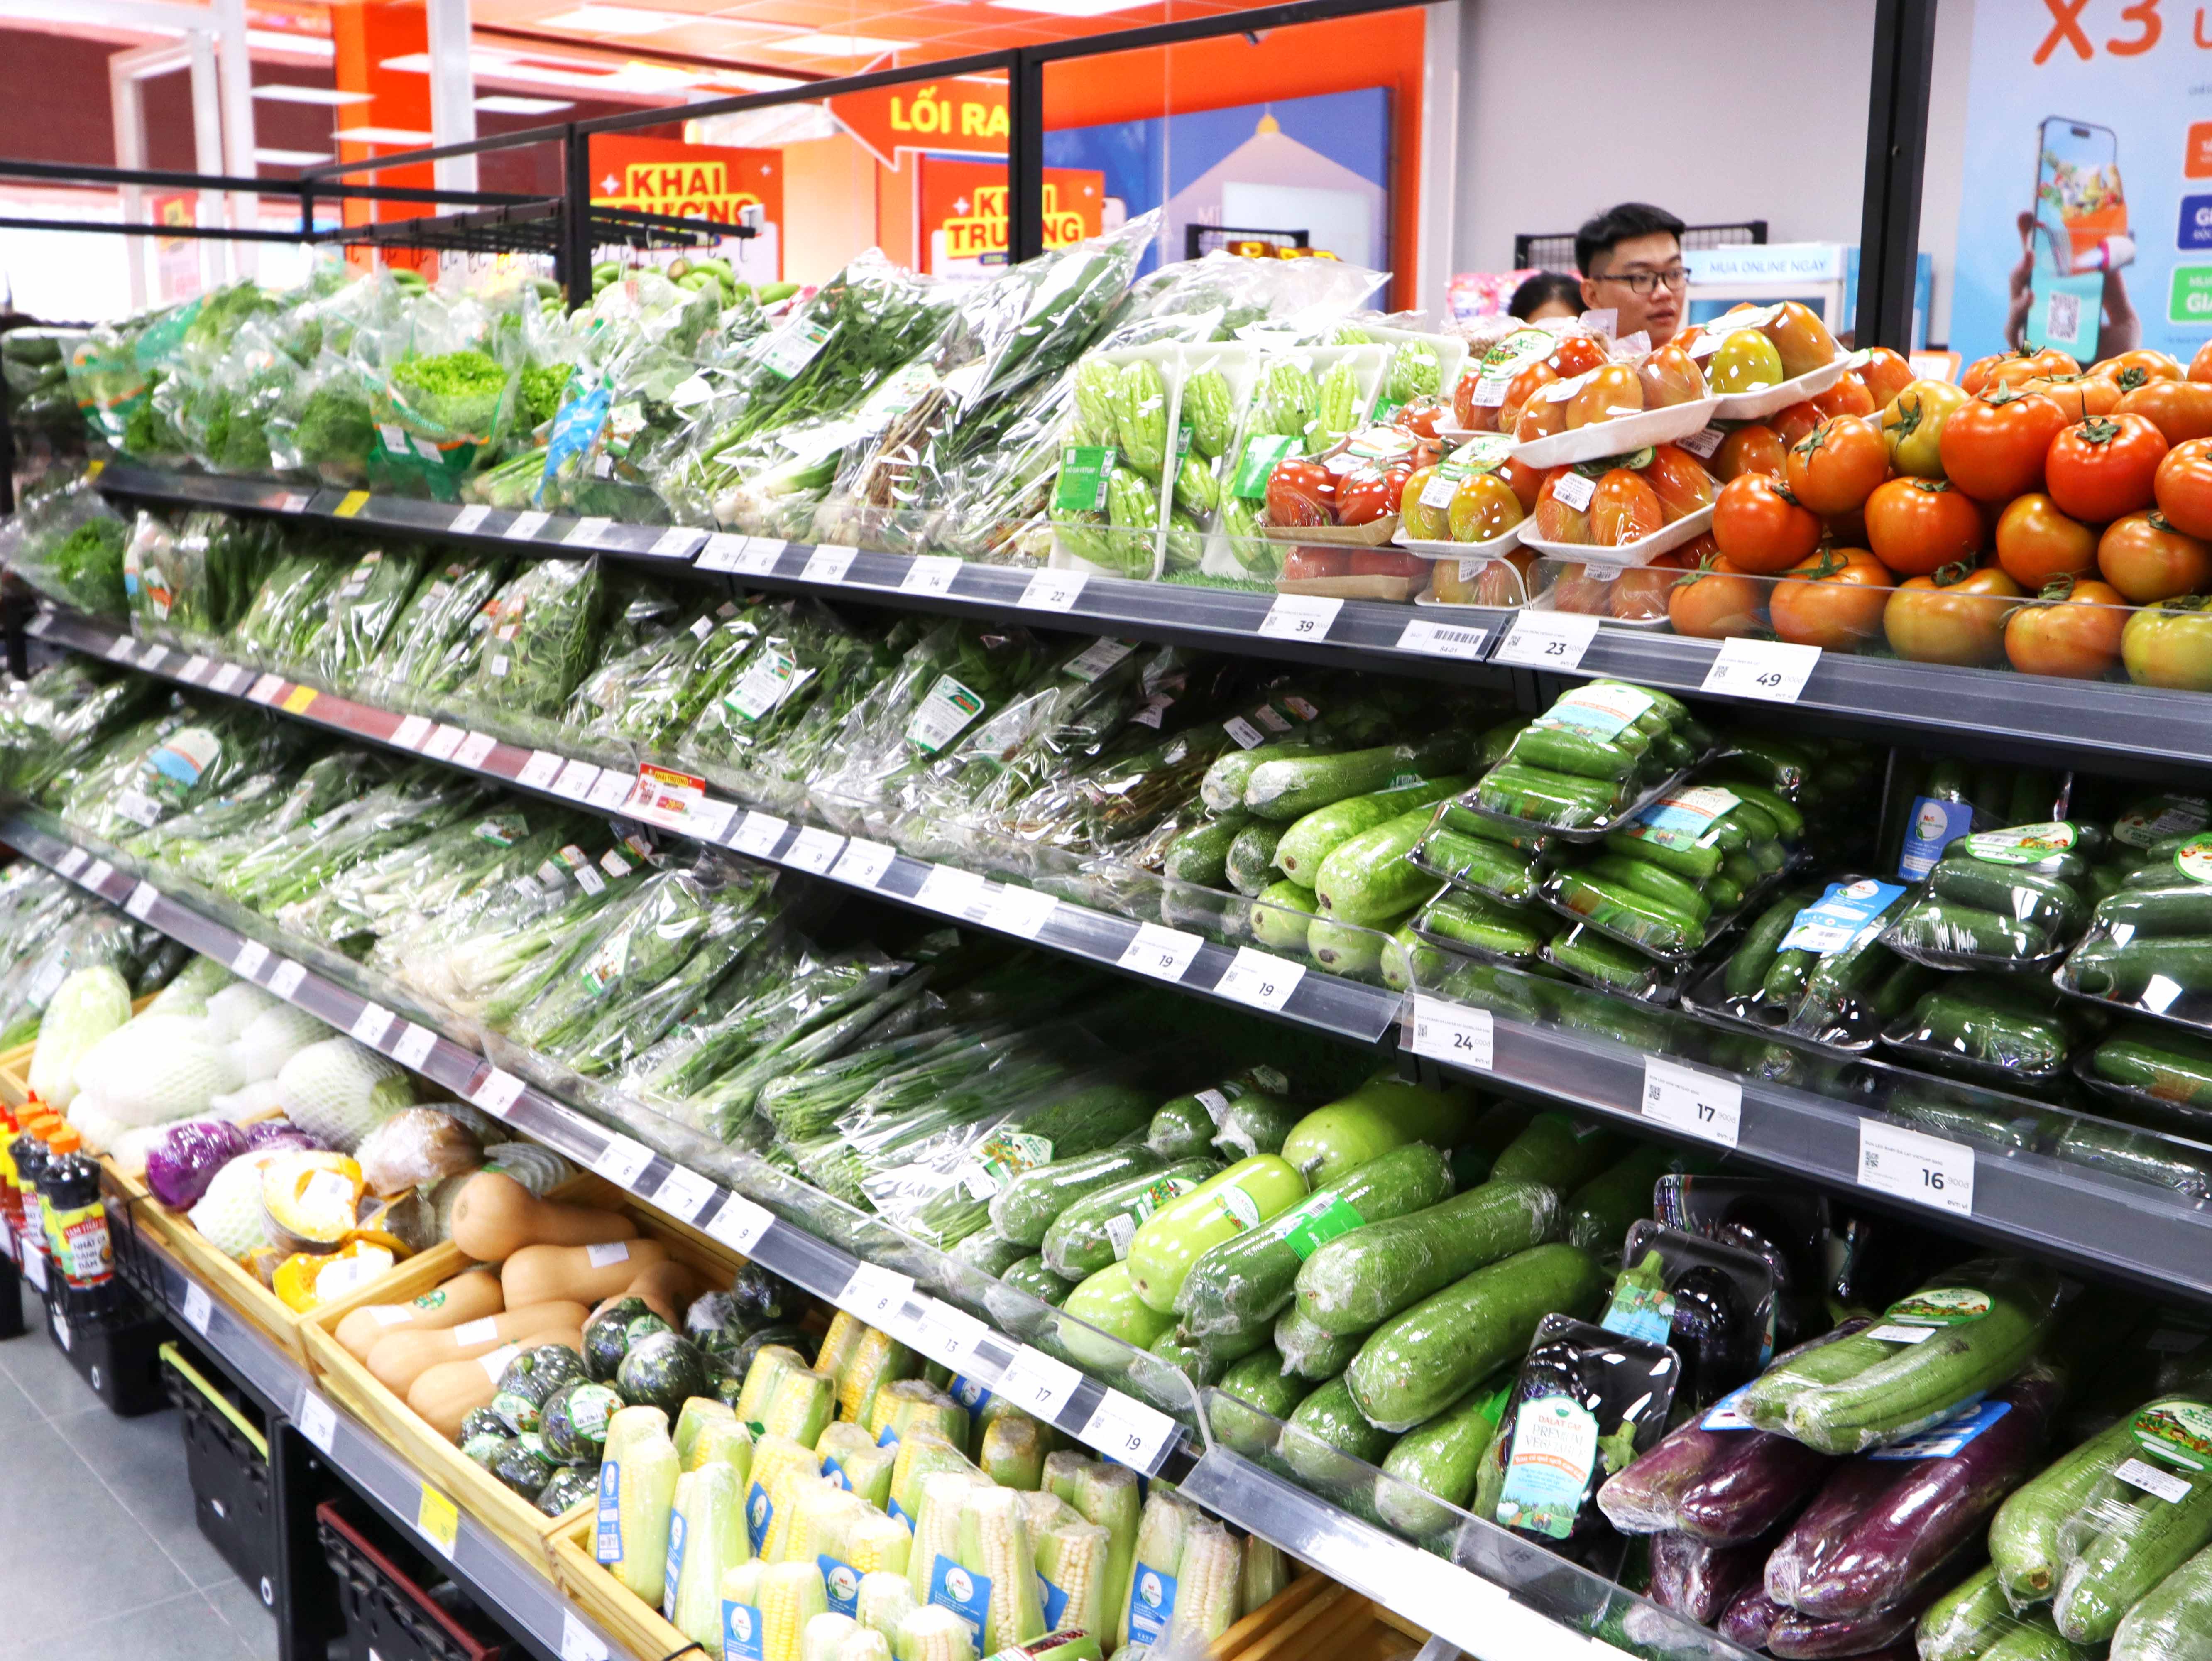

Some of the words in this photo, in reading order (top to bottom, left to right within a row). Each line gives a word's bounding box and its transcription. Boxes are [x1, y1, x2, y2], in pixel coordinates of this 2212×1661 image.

[891, 86, 952, 134] LỐI
[962, 103, 1009, 137] RA
[632, 168, 722, 198] KHAI
[1710, 259, 1737, 273] MUA
[1741, 259, 1787, 273] ONLINE
[1791, 259, 1827, 273] NGAY
[1049, 591, 1065, 602] 22
[1295, 620, 1314, 632] 39
[1544, 641, 1567, 656] 23
[1756, 672, 1781, 687] 49
[1159, 955, 1173, 968] 19
[1258, 982, 1275, 997] 19
[1454, 1033, 1473, 1051] 24
[1697, 1103, 1715, 1123] 17
[1922, 1168, 1944, 1190] 16
[684, 1198, 693, 1209] 7
[878, 1298, 888, 1310] 8
[944, 1338, 959, 1353] 13
[1035, 1387, 1052, 1402] 17
[1539, 1415, 1566, 1428] DALAT
[1568, 1422, 1582, 1431] GAP
[1125, 1434, 1142, 1451] 19
